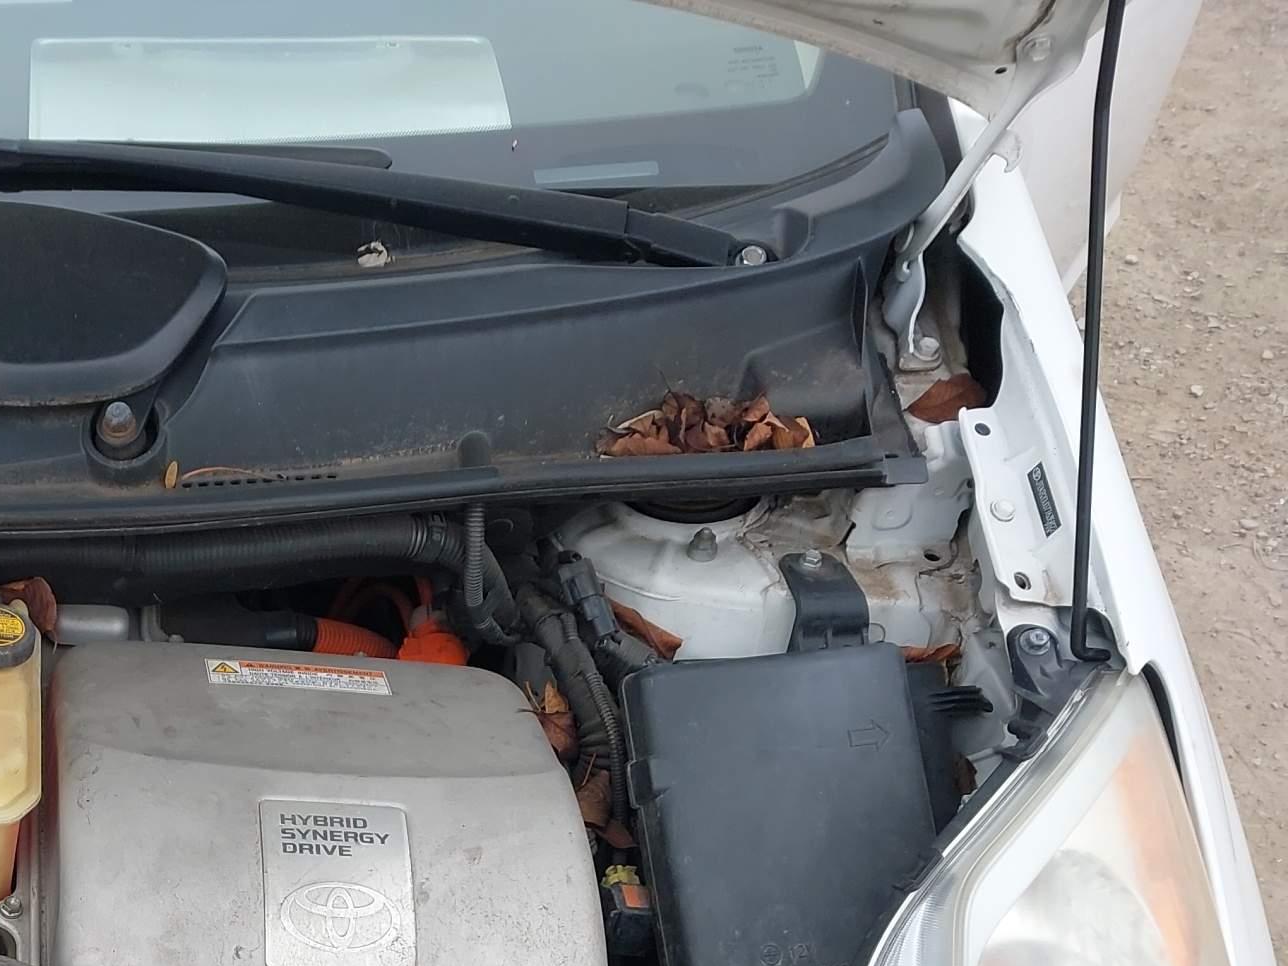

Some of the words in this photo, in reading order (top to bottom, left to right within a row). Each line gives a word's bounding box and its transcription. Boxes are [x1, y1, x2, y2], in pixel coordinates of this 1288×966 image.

[280, 813, 368, 829] HYBRID
[281, 828, 389, 845] SYNERGY
[282, 842, 352, 857] DRIVE
